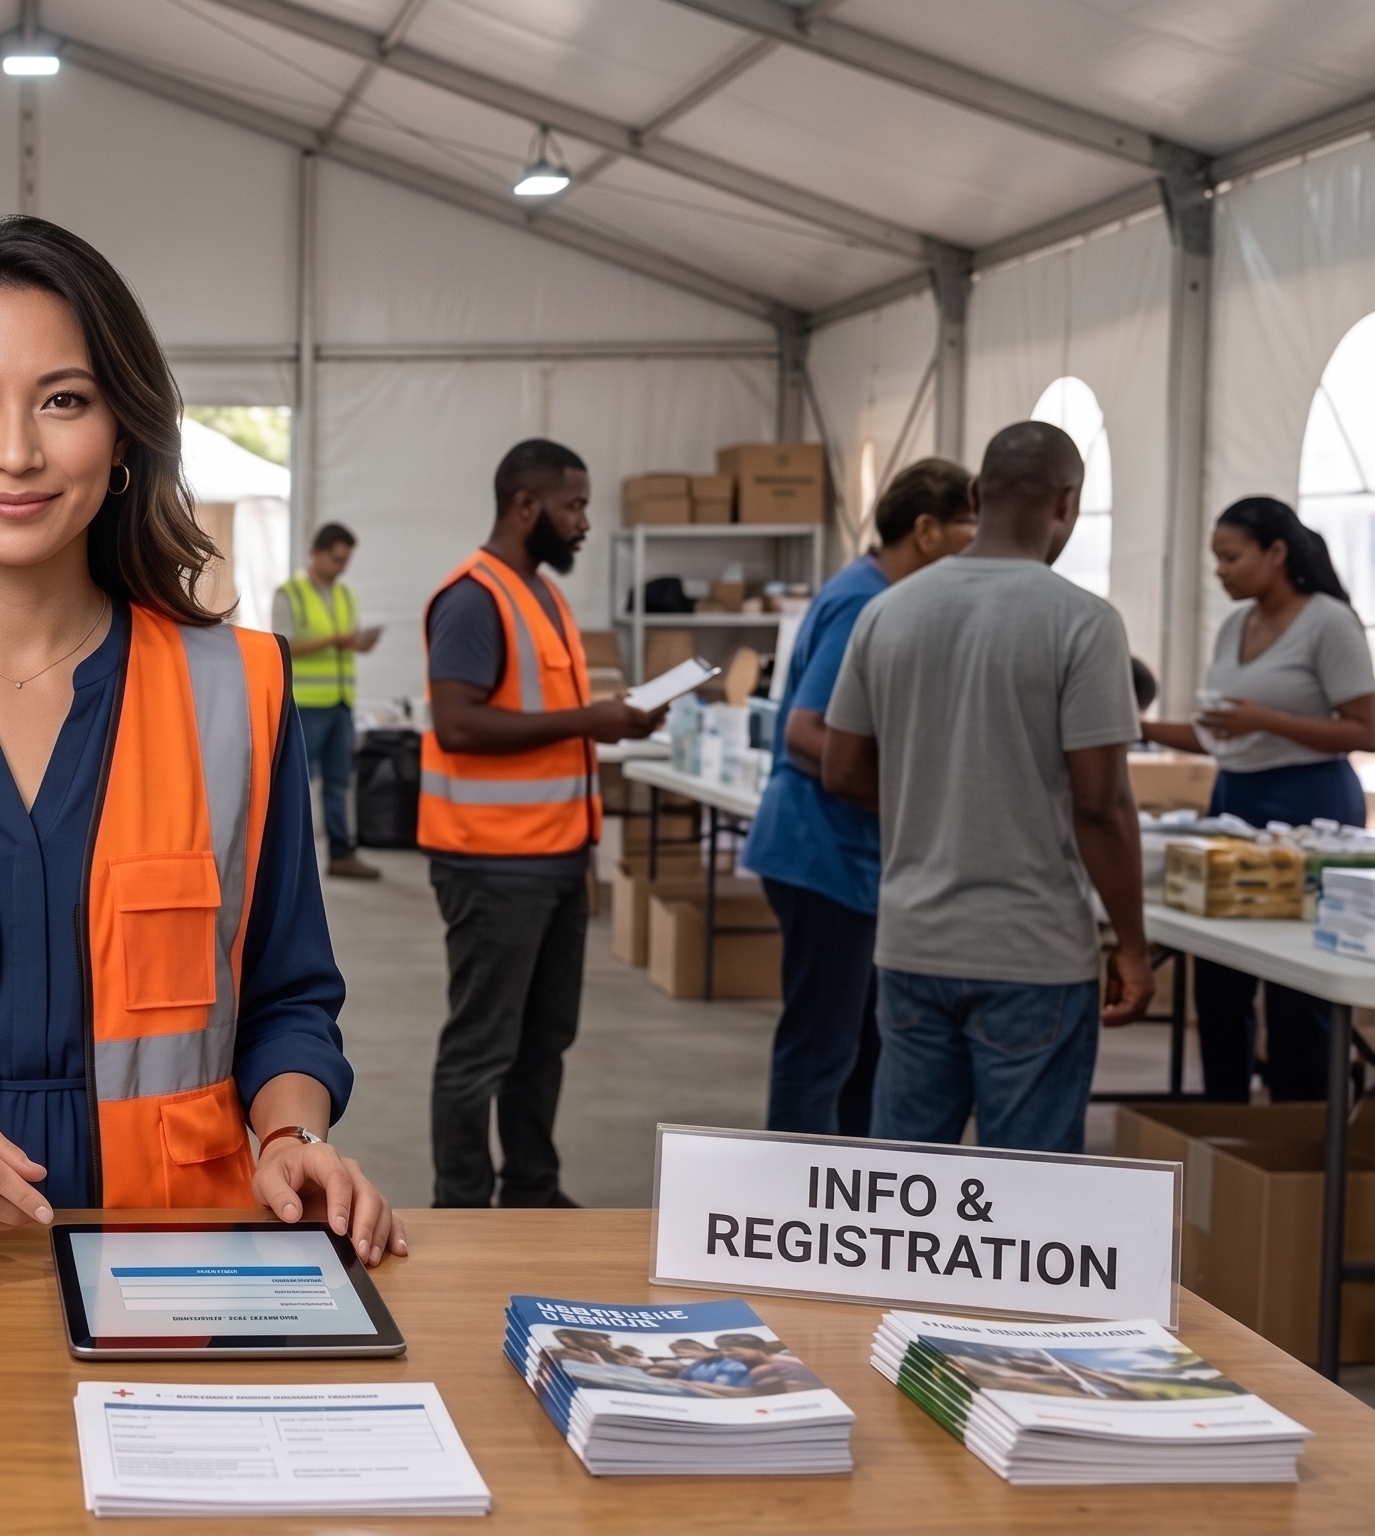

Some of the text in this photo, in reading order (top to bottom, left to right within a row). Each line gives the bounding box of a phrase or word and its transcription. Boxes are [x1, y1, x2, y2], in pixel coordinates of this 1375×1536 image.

[808, 1165, 994, 1223] INFO &
[706, 1212, 1118, 1291] REGISTRATION
